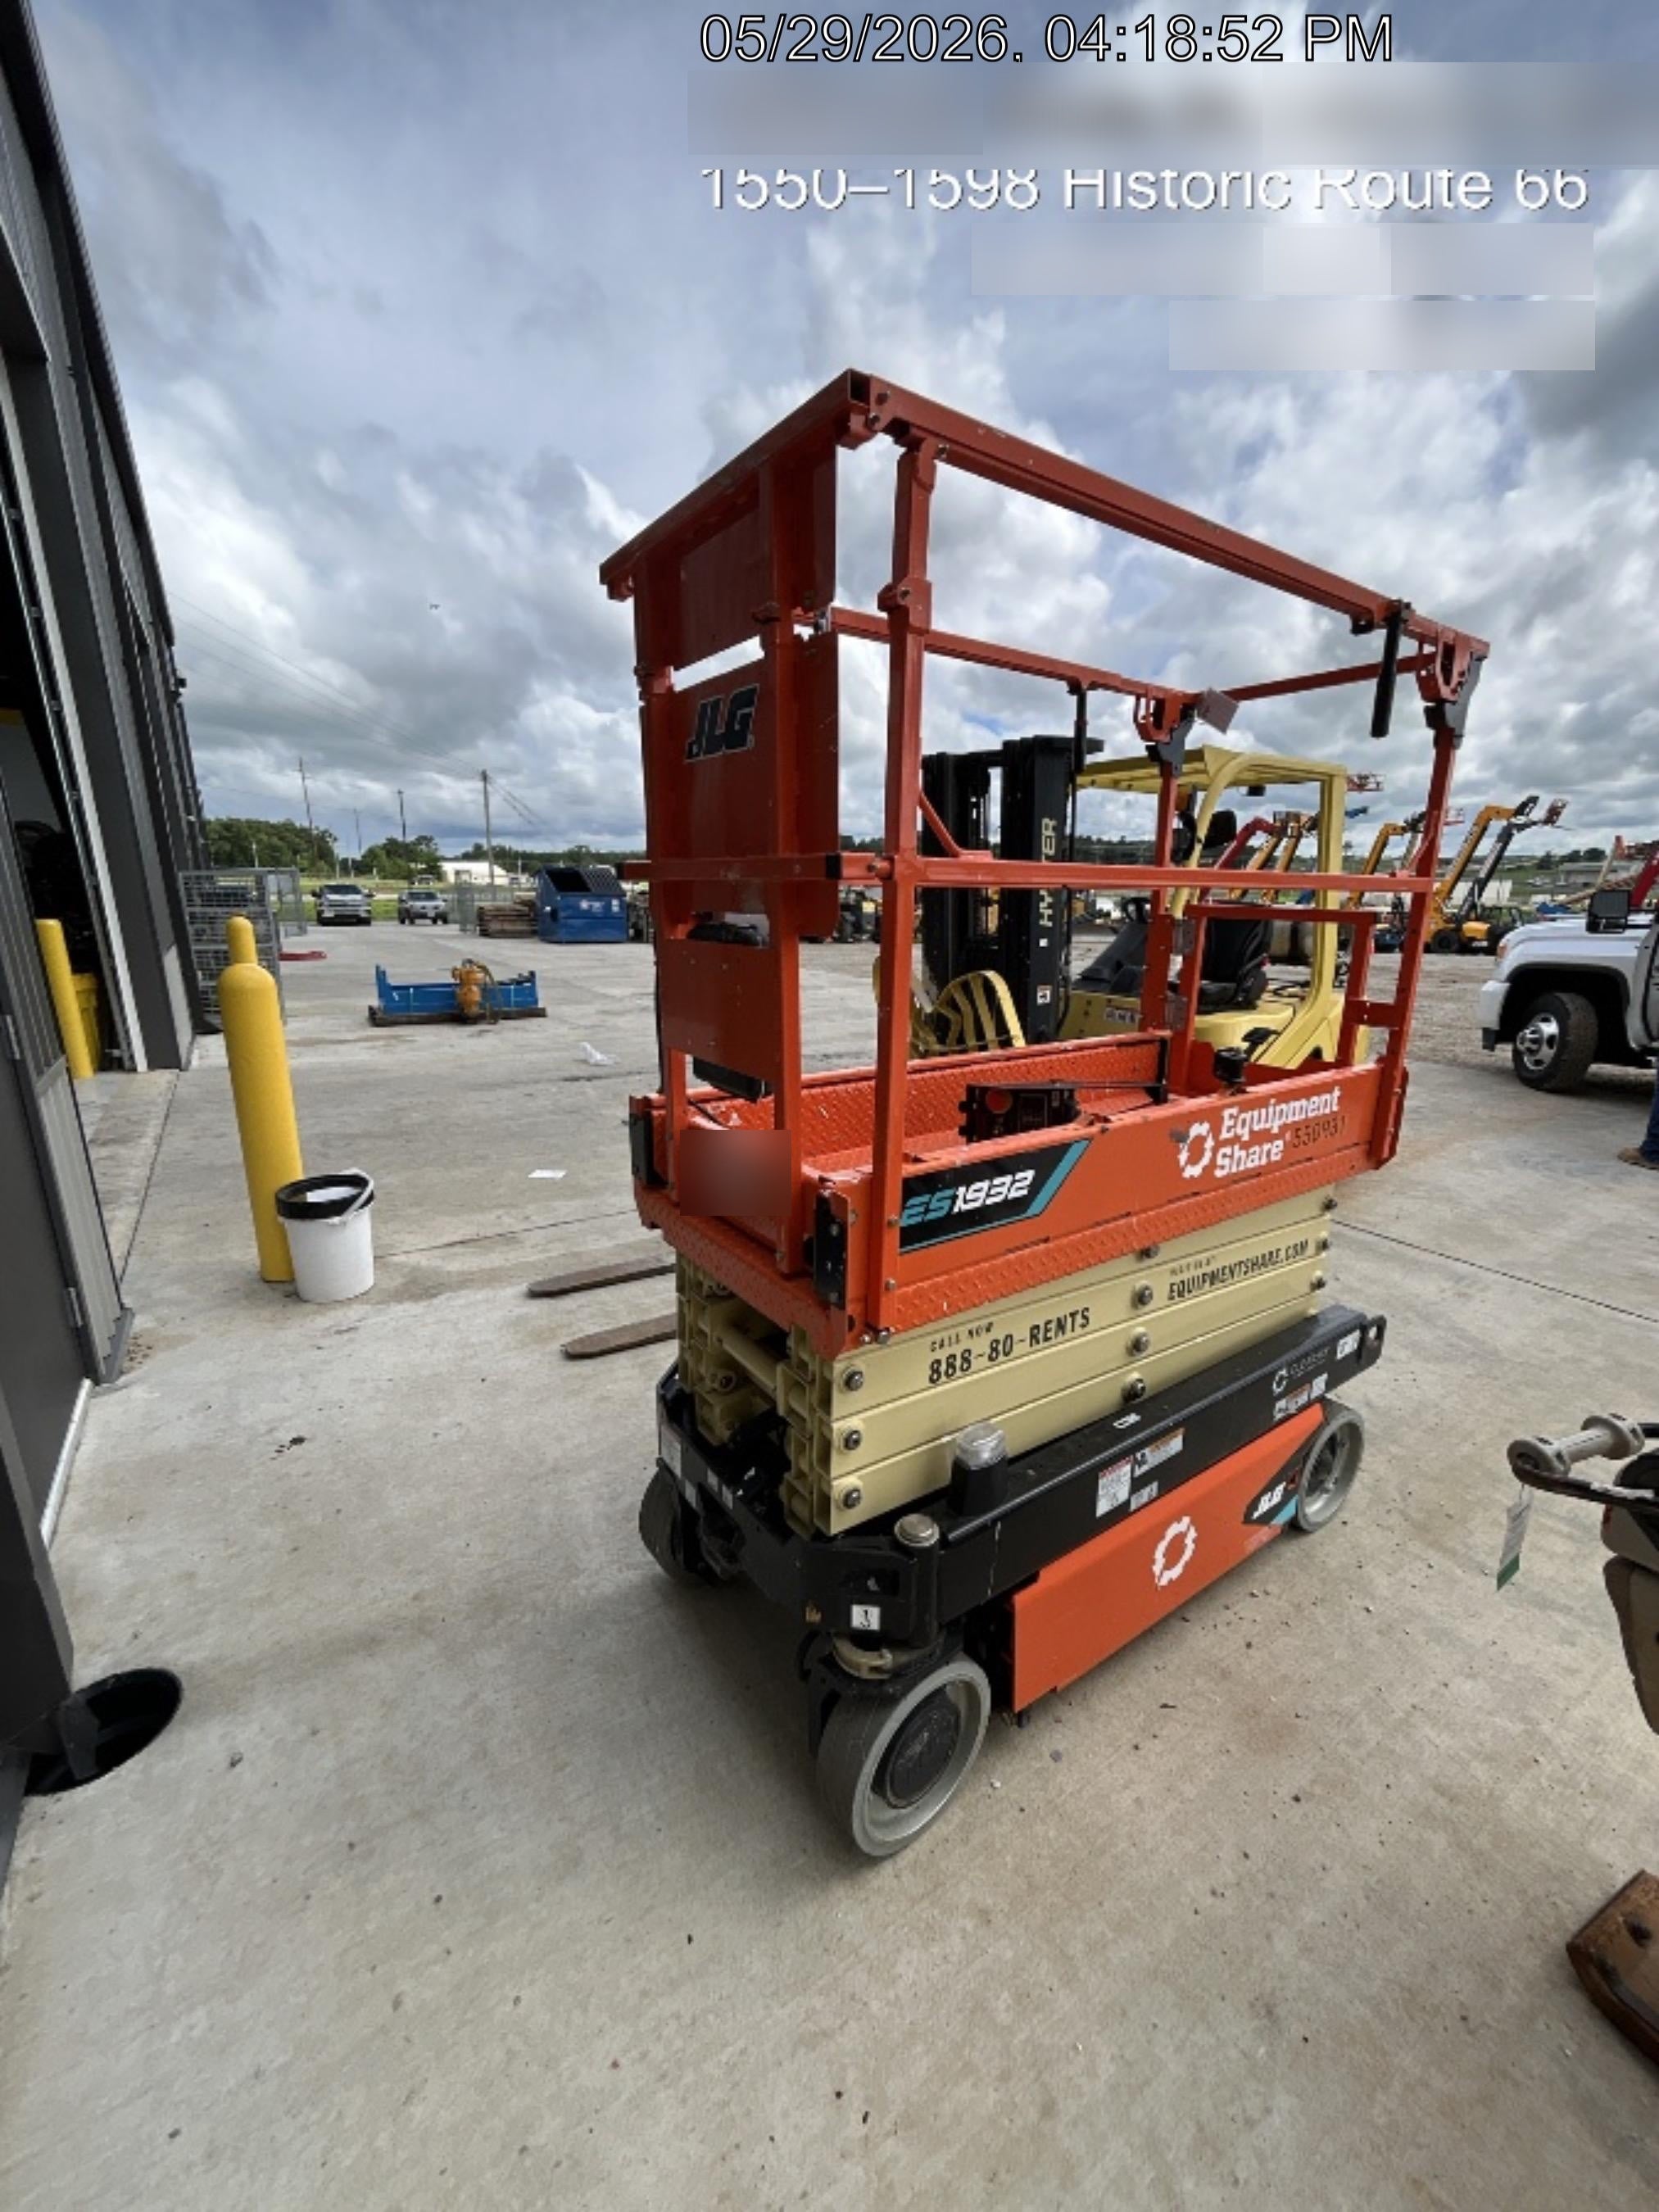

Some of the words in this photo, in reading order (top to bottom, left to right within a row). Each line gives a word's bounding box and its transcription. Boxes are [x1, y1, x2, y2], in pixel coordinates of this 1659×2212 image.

[685, 683, 759, 761] JLG
[1038, 818, 1058, 928] HYER
[1219, 1086, 1341, 1141] Equipment
[1213, 1139, 1284, 1177] Share
[900, 1169, 1036, 1226] ES1932
[928, 1307, 1090, 1384] 888-80-RENTS
